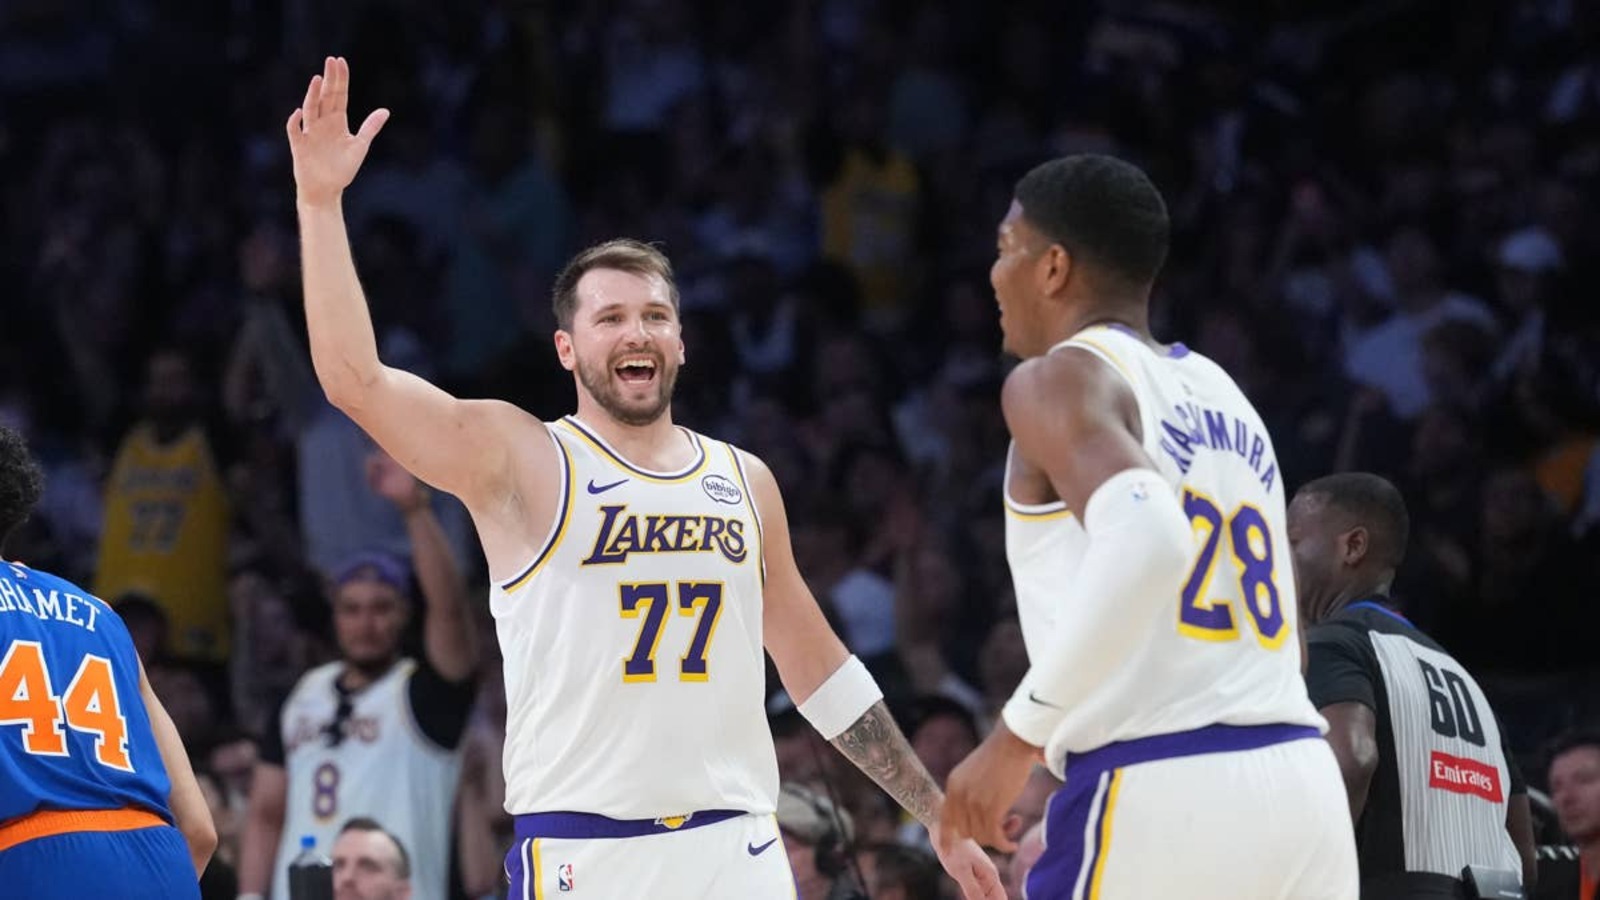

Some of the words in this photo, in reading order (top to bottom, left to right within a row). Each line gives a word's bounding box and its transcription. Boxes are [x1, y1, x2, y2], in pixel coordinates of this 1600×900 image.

[580, 504, 748, 567] LAKERS
[1178, 486, 1290, 650] 28
[618, 580, 724, 684] 77
[0, 639, 136, 774] 44
[1417, 657, 1486, 748] 60
[314, 762, 340, 824] 8
[1432, 760, 1494, 792] Emirates
